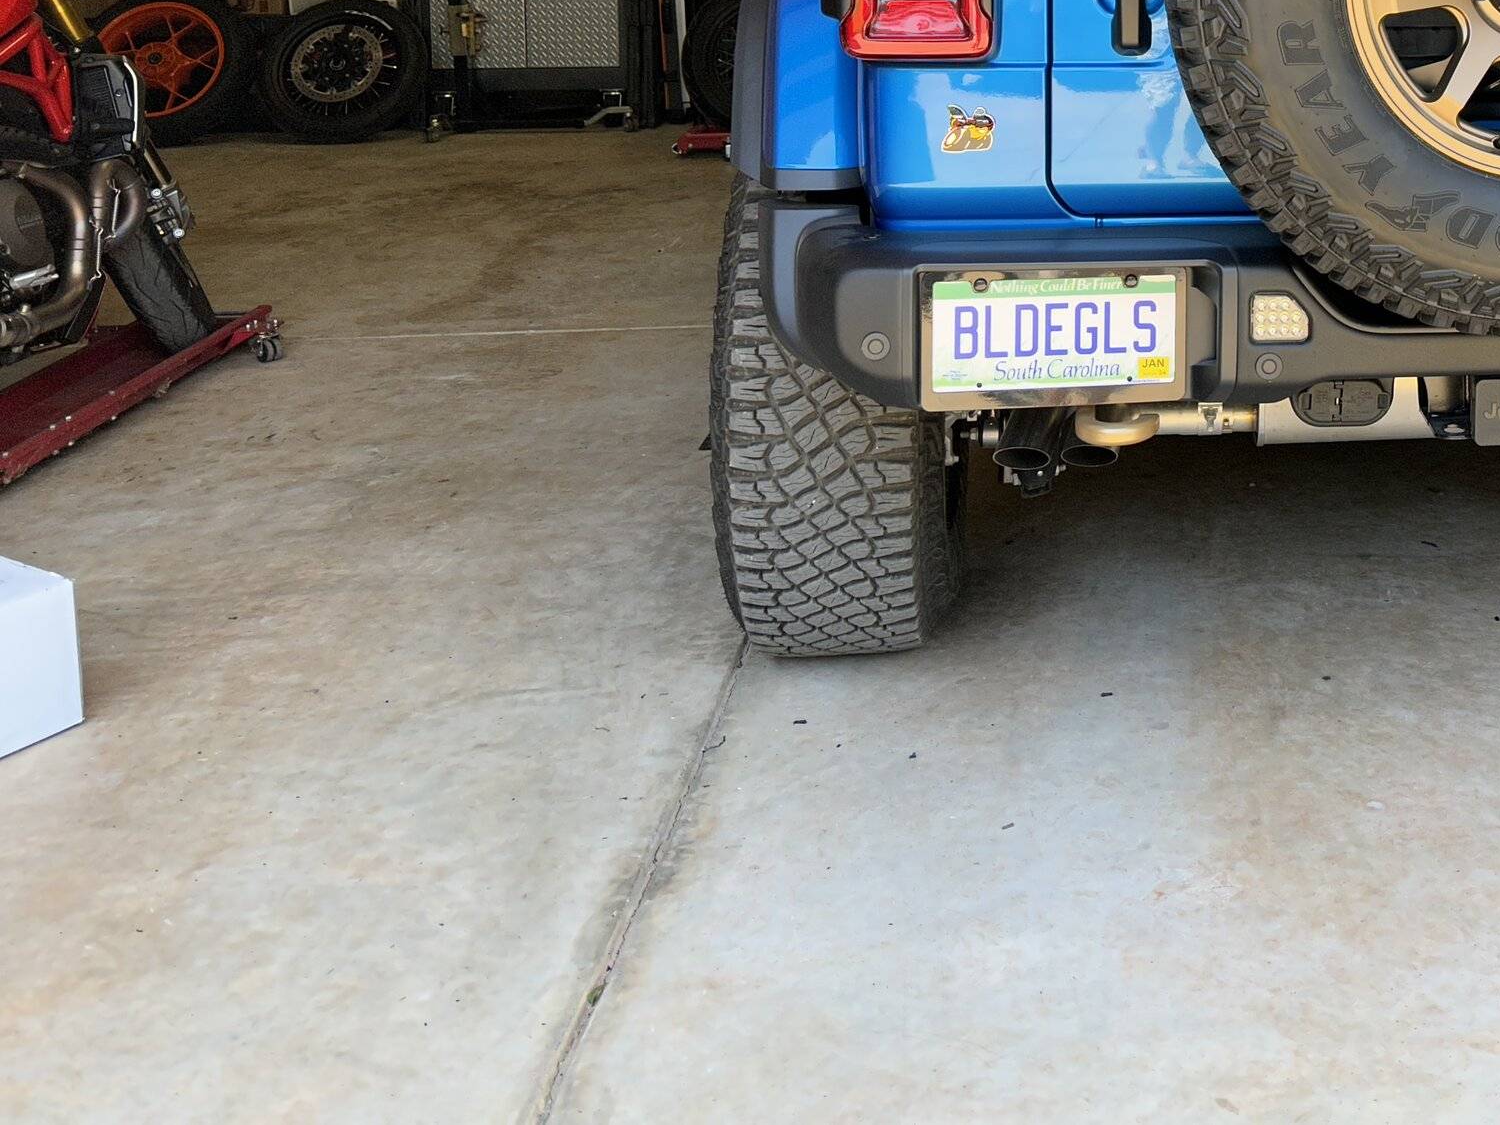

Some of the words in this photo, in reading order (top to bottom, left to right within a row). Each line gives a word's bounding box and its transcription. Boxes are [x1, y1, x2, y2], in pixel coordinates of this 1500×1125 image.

[990, 280, 1038, 295] Nothing
[1040, 278, 1076, 292] Could
[1077, 279, 1092, 291] Be
[954, 300, 1157, 360] BLDEGLS
[993, 359, 1042, 381] South
[1046, 357, 1121, 380] Carolina
[1142, 358, 1165, 368] JAN
